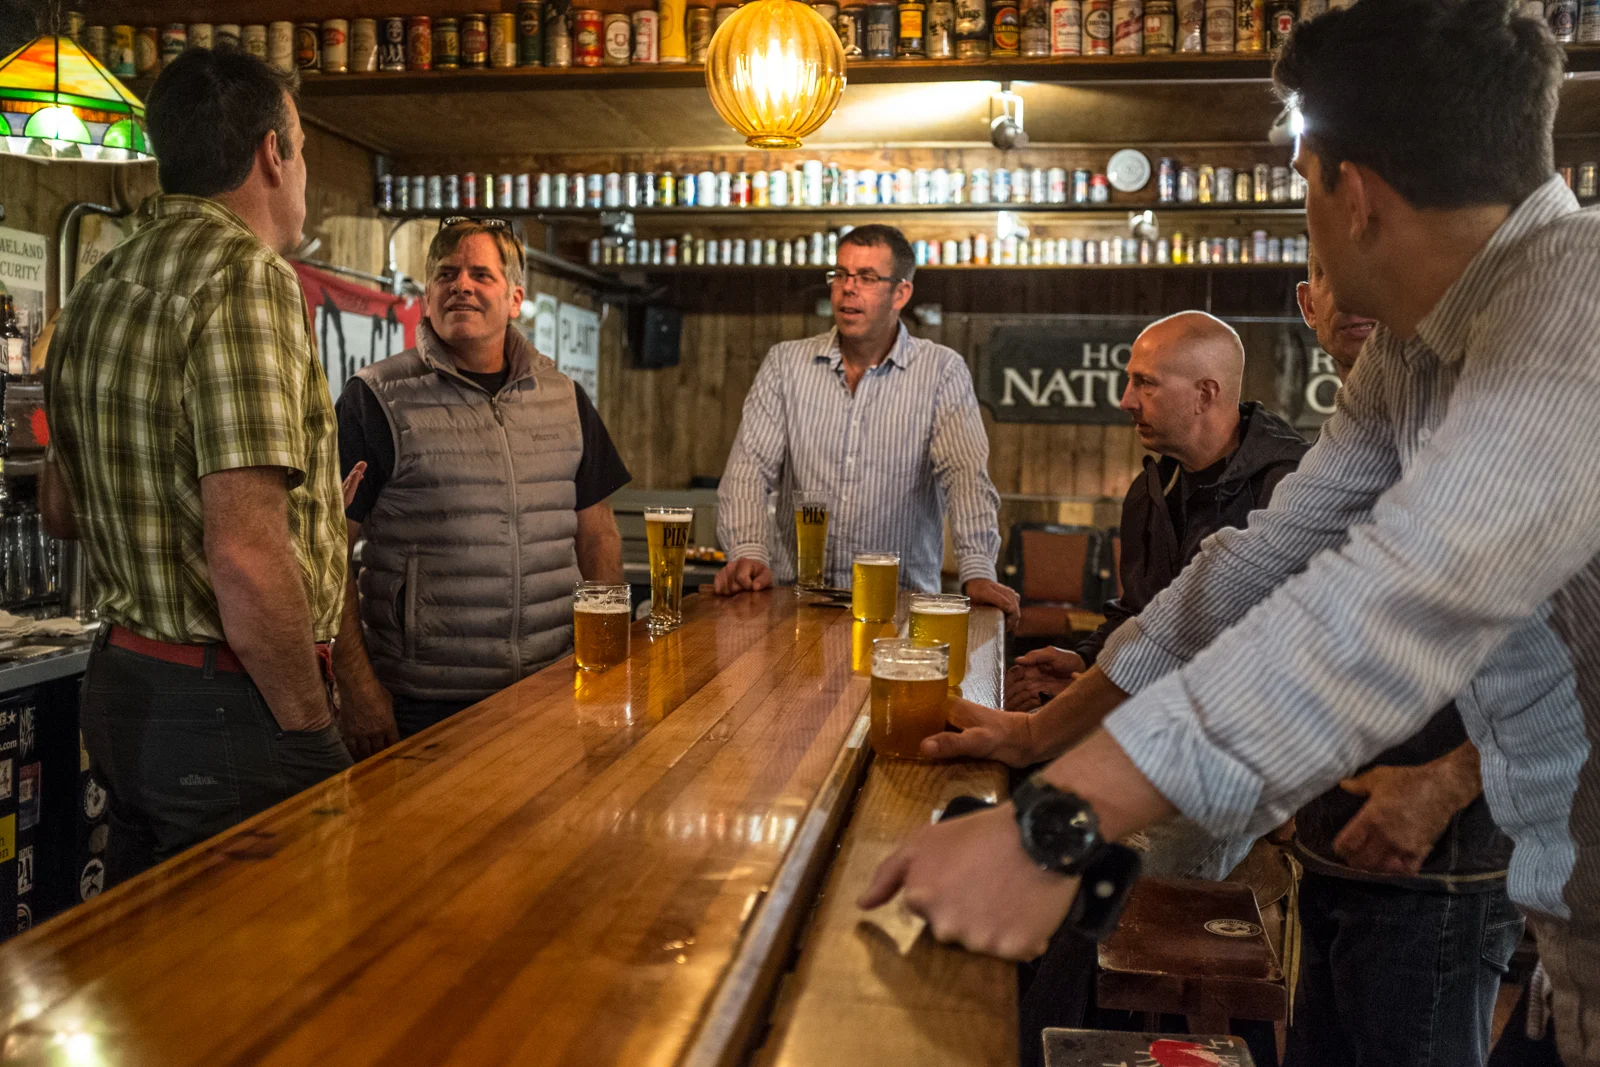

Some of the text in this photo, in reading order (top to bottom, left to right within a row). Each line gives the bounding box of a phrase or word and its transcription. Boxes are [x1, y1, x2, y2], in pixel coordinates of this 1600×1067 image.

[802, 506, 826, 524] PILS
[663, 527, 687, 546] PILS
[0, 739, 17, 752] .com
